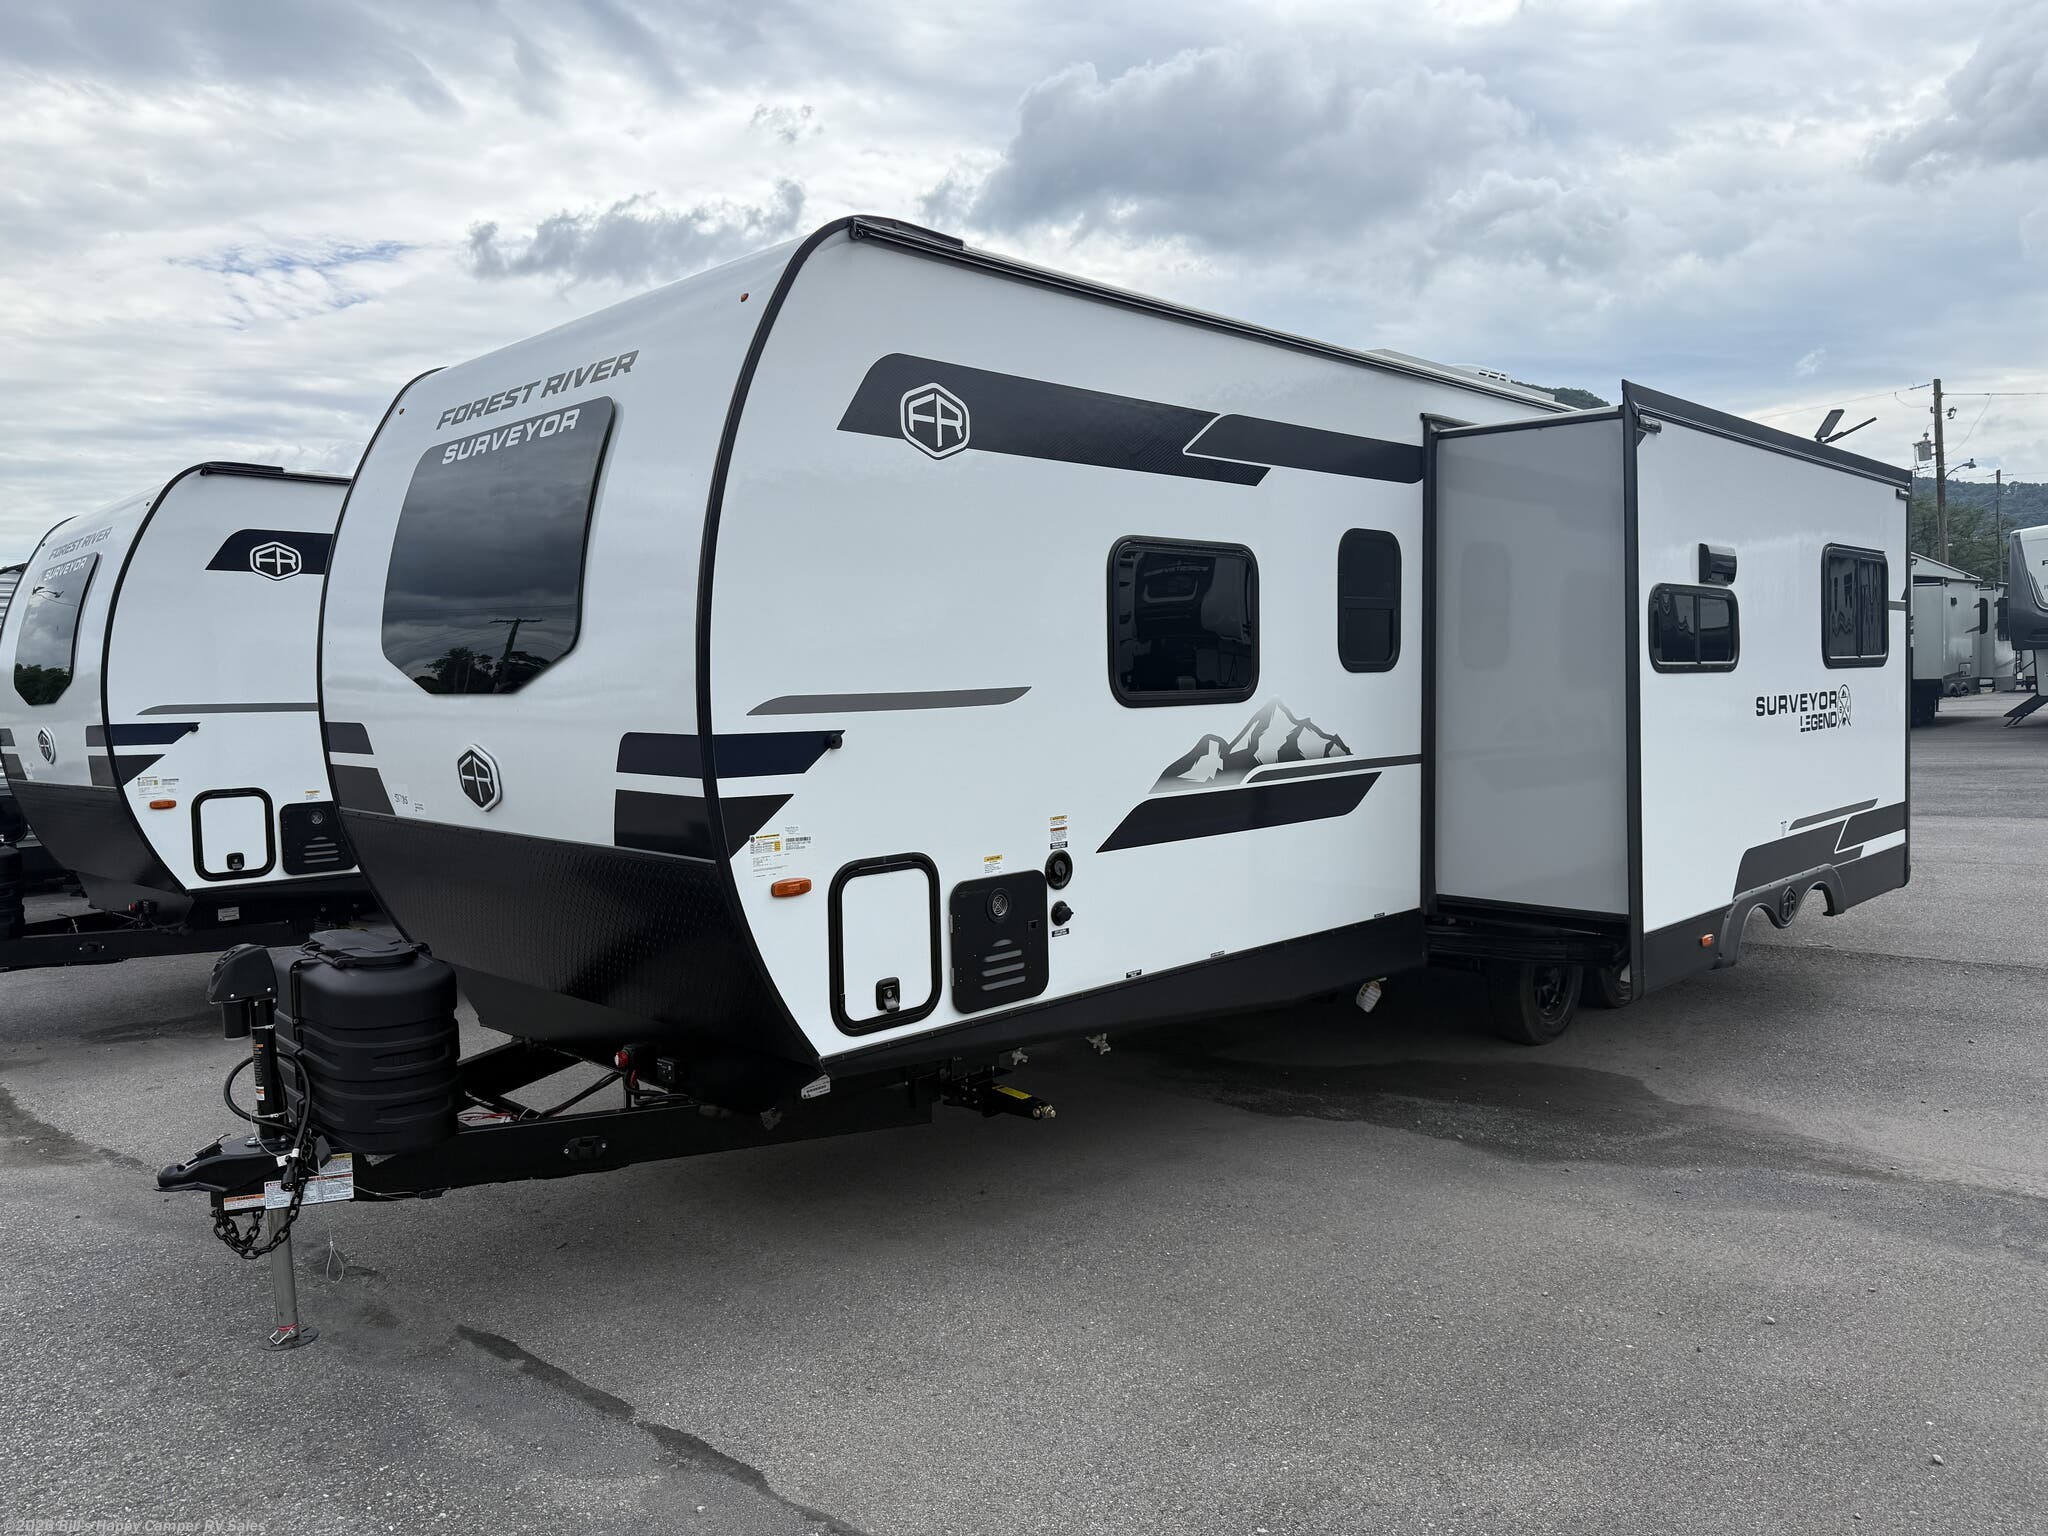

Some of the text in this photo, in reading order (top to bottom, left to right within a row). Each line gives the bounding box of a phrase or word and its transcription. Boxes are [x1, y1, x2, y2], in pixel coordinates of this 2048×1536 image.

[436, 350, 640, 430] FOREST RIVER
[441, 408, 581, 465] SURVEYOR
[49, 526, 113, 560] FOREST RIVER
[43, 557, 88, 581] SURVEYOR
[1755, 690, 1838, 717] SURVEYOR
[1800, 711, 1838, 733] LEGEND
